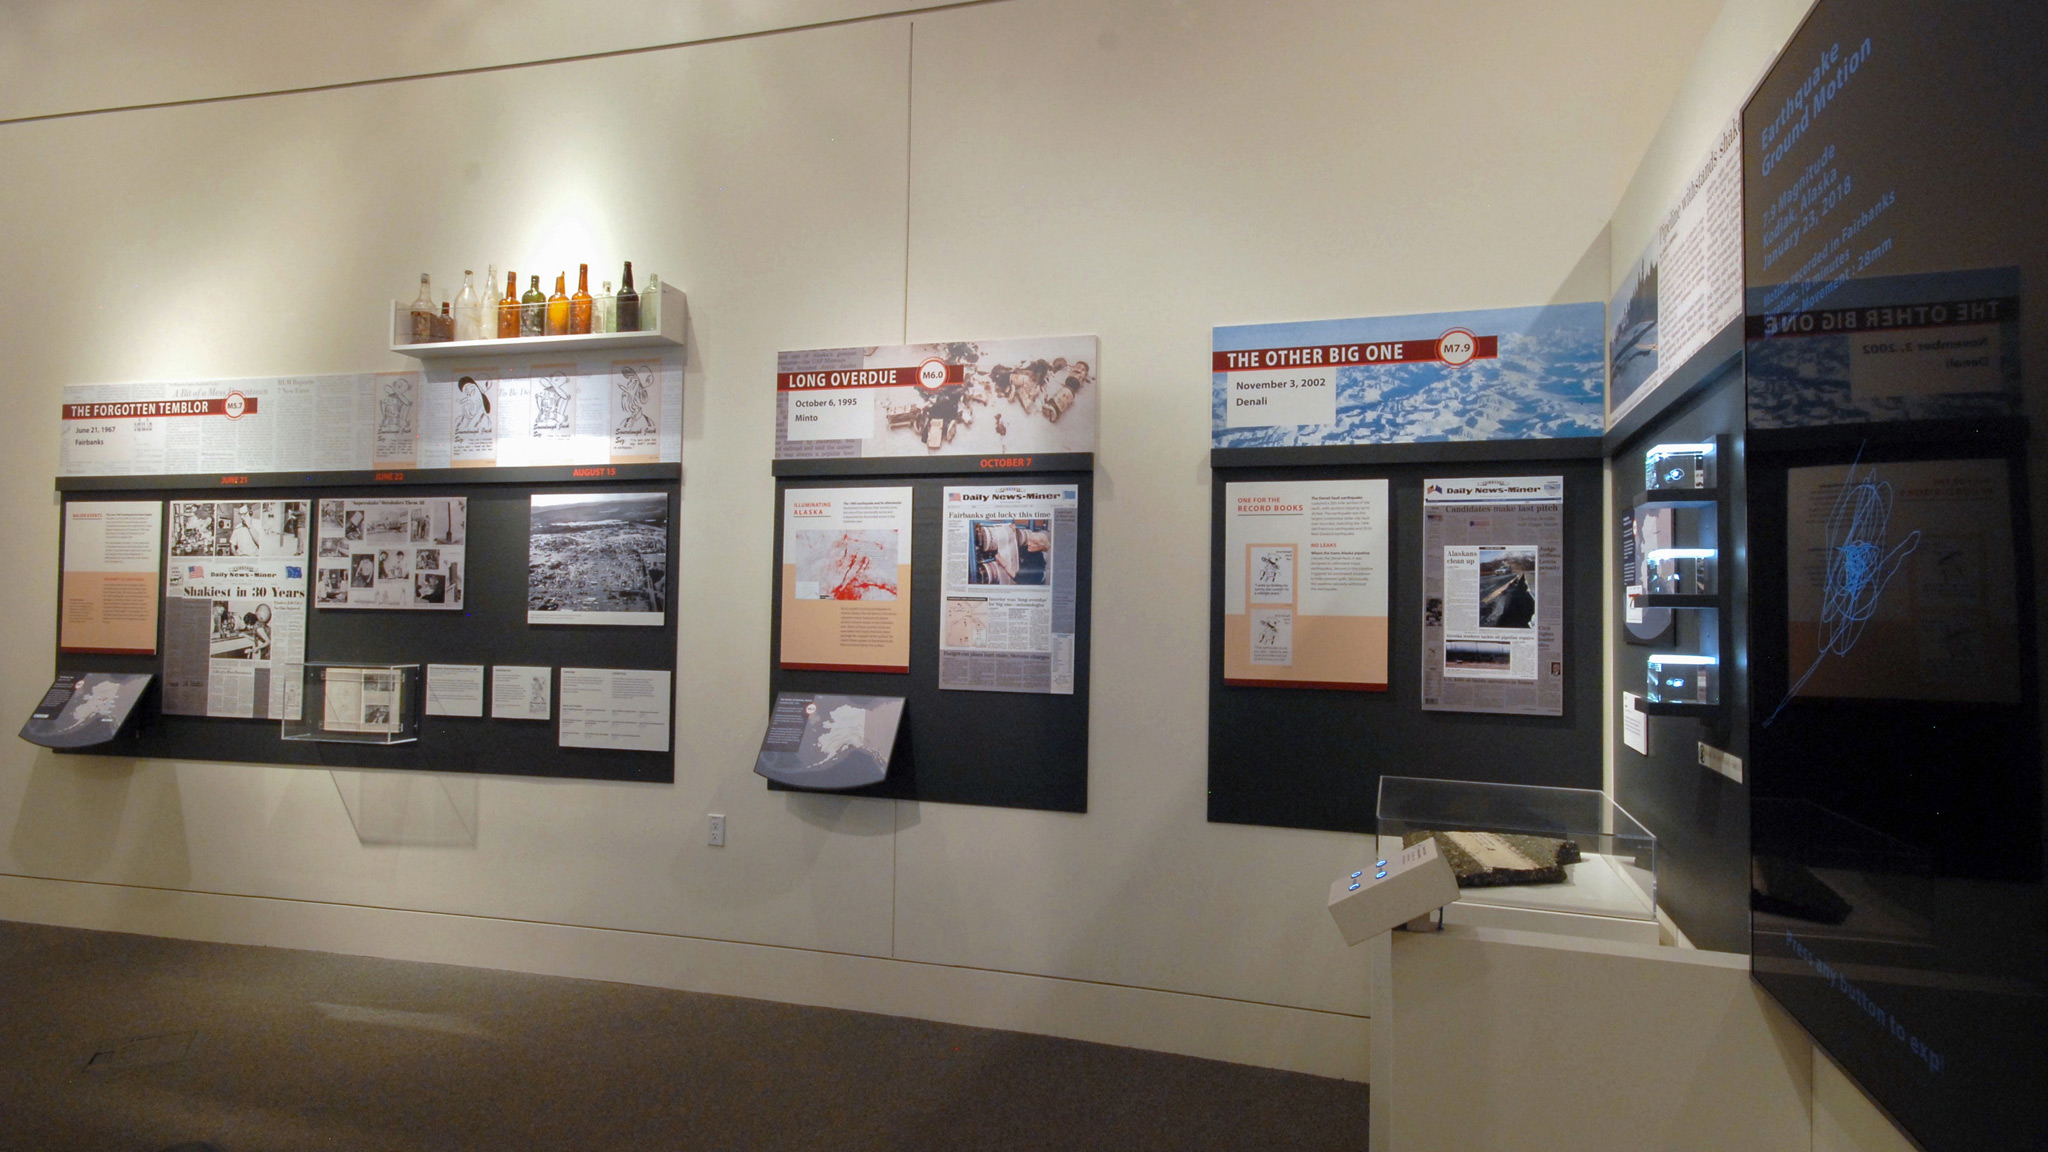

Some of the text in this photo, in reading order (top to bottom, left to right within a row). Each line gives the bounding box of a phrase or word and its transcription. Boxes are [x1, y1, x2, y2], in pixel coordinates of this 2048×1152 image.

[1761, 42, 1840, 151] Earthquake
[1761, 36, 1872, 177] Ground Motion
[1762, 144, 1836, 229] 7.9 Magnitude
[1658, 205, 1681, 246] Pipeline
[1681, 150, 1718, 212] withstands
[1762, 167, 1838, 249] Kodiak, Alaska
[1762, 174, 1852, 273] January 23, 2018
[1763, 188, 1896, 309] Motion recorded in Fairbanks
[1812, 248, 1851, 287] minutes
[1801, 267, 1850, 314] Movement
[1857, 236, 1894, 272] 28mm
[1443, 343, 1471, 354] M7.9
[1227, 343, 1404, 368] THE OTHER BIG ONE
[789, 370, 897, 388] LONG OVERDUE
[922, 371, 943, 379] M6.0
[1236, 377, 1326, 391] November 3, 2002
[227, 402, 243, 410] M5.7
[795, 398, 857, 408] October 6, 1995
[1236, 396, 1268, 407] Denali
[71, 401, 209, 417] THE FORGOTTEN TEMBLOR
[794, 414, 819, 422] Minto
[480, 427, 492, 435] Jack
[615, 427, 656, 436] Sourdough Jack
[980, 457, 1033, 468] OCTOBER 7
[572, 467, 616, 477] AUGUST 15
[221, 476, 248, 484] JUNE 21
[1446, 486, 1542, 496] Daily News-Miner
[962, 492, 1061, 502] Daily News-Miner
[793, 508, 824, 516] ALASKA
[1237, 504, 1272, 512] RECORD
[1273, 504, 1304, 512] BOOKS
[1445, 503, 1558, 513] Candidates make last pitch
[948, 511, 984, 519] Fairbanks
[985, 512, 996, 520] got
[997, 511, 1017, 520] lucky
[1466, 558, 1475, 566] up
[183, 585, 306, 598] Shakiest in 30 Years
[1786, 928, 1813, 967] Press
[1815, 957, 1837, 988] any
[1839, 971, 1887, 1028] button
[1888, 1014, 1907, 1043] to
